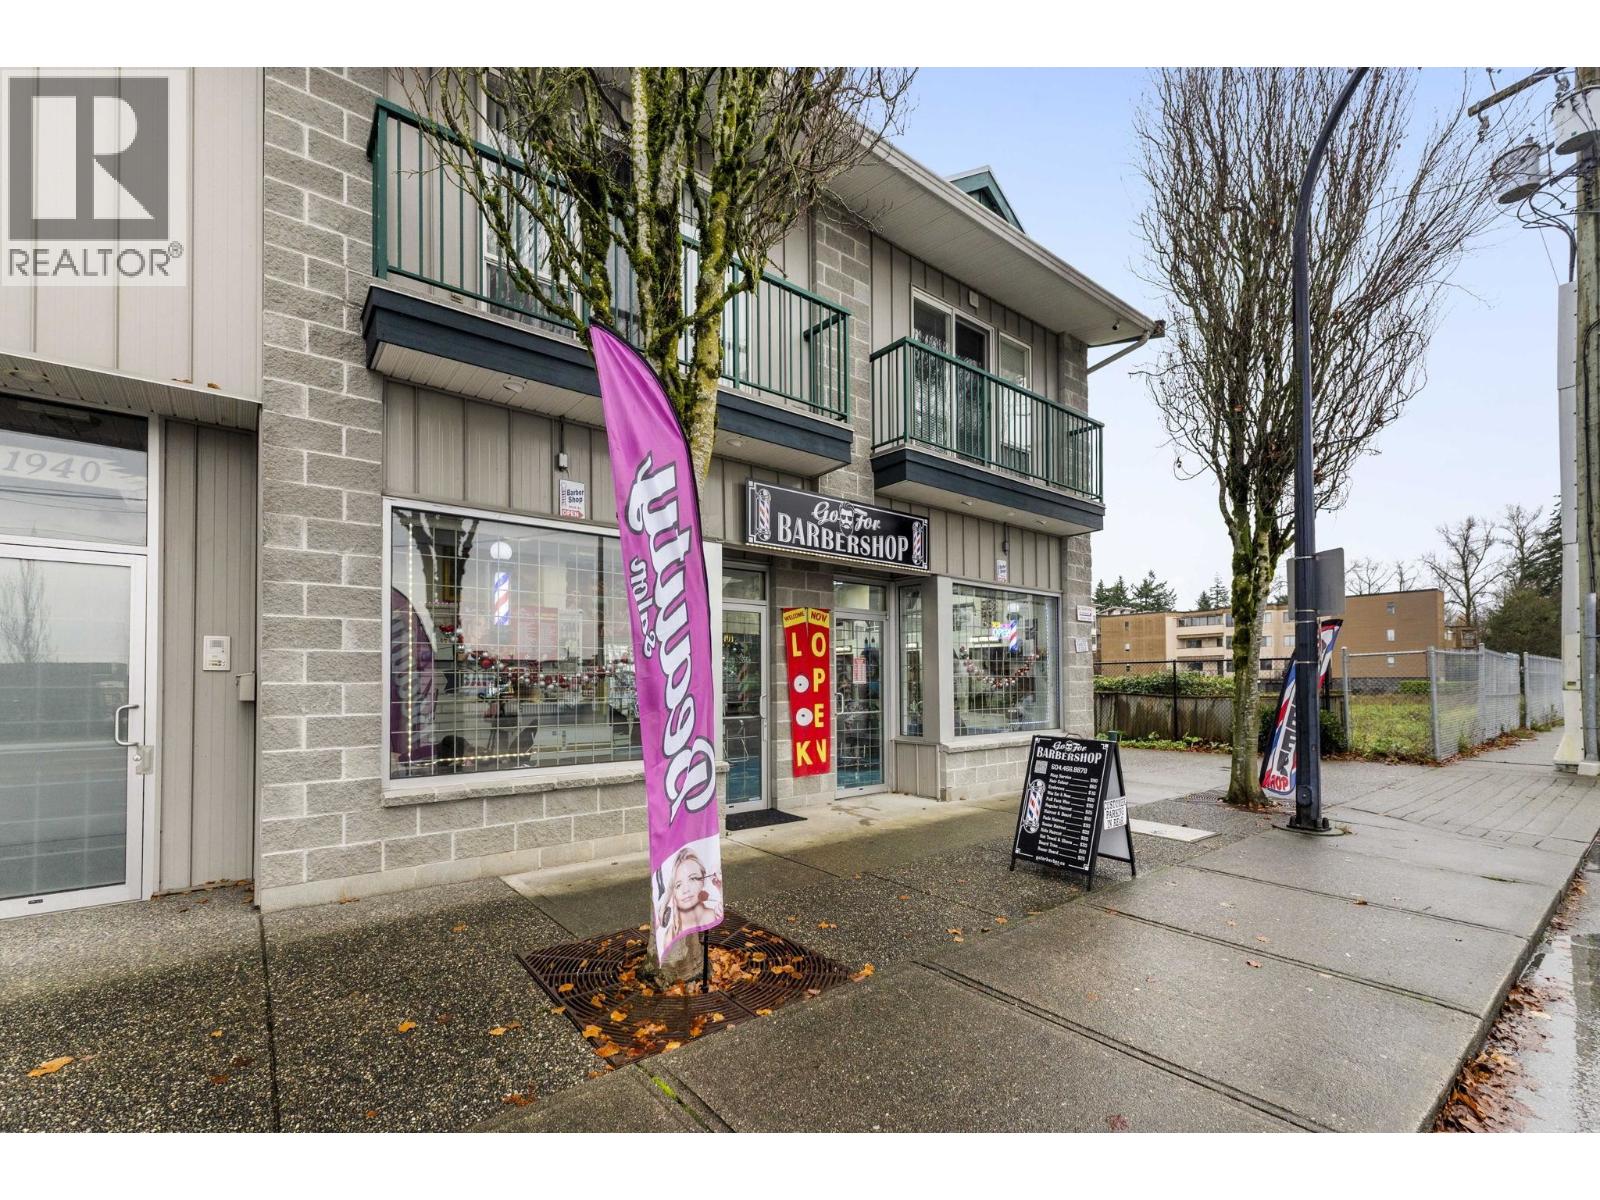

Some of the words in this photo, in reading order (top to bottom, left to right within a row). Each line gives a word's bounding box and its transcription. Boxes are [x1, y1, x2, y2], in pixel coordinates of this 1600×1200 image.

[2, 450, 101, 483] 1940
[566, 489, 585, 497] Barber
[568, 496, 583, 505] Shop
[811, 501, 840, 526] Go
[855, 508, 881, 532] For
[777, 511, 909, 561] BARBERSHOP
[783, 611, 806, 622] WELCOME
[810, 611, 828, 623] NOW
[1036, 746, 1103, 764] BARBERSHOP
